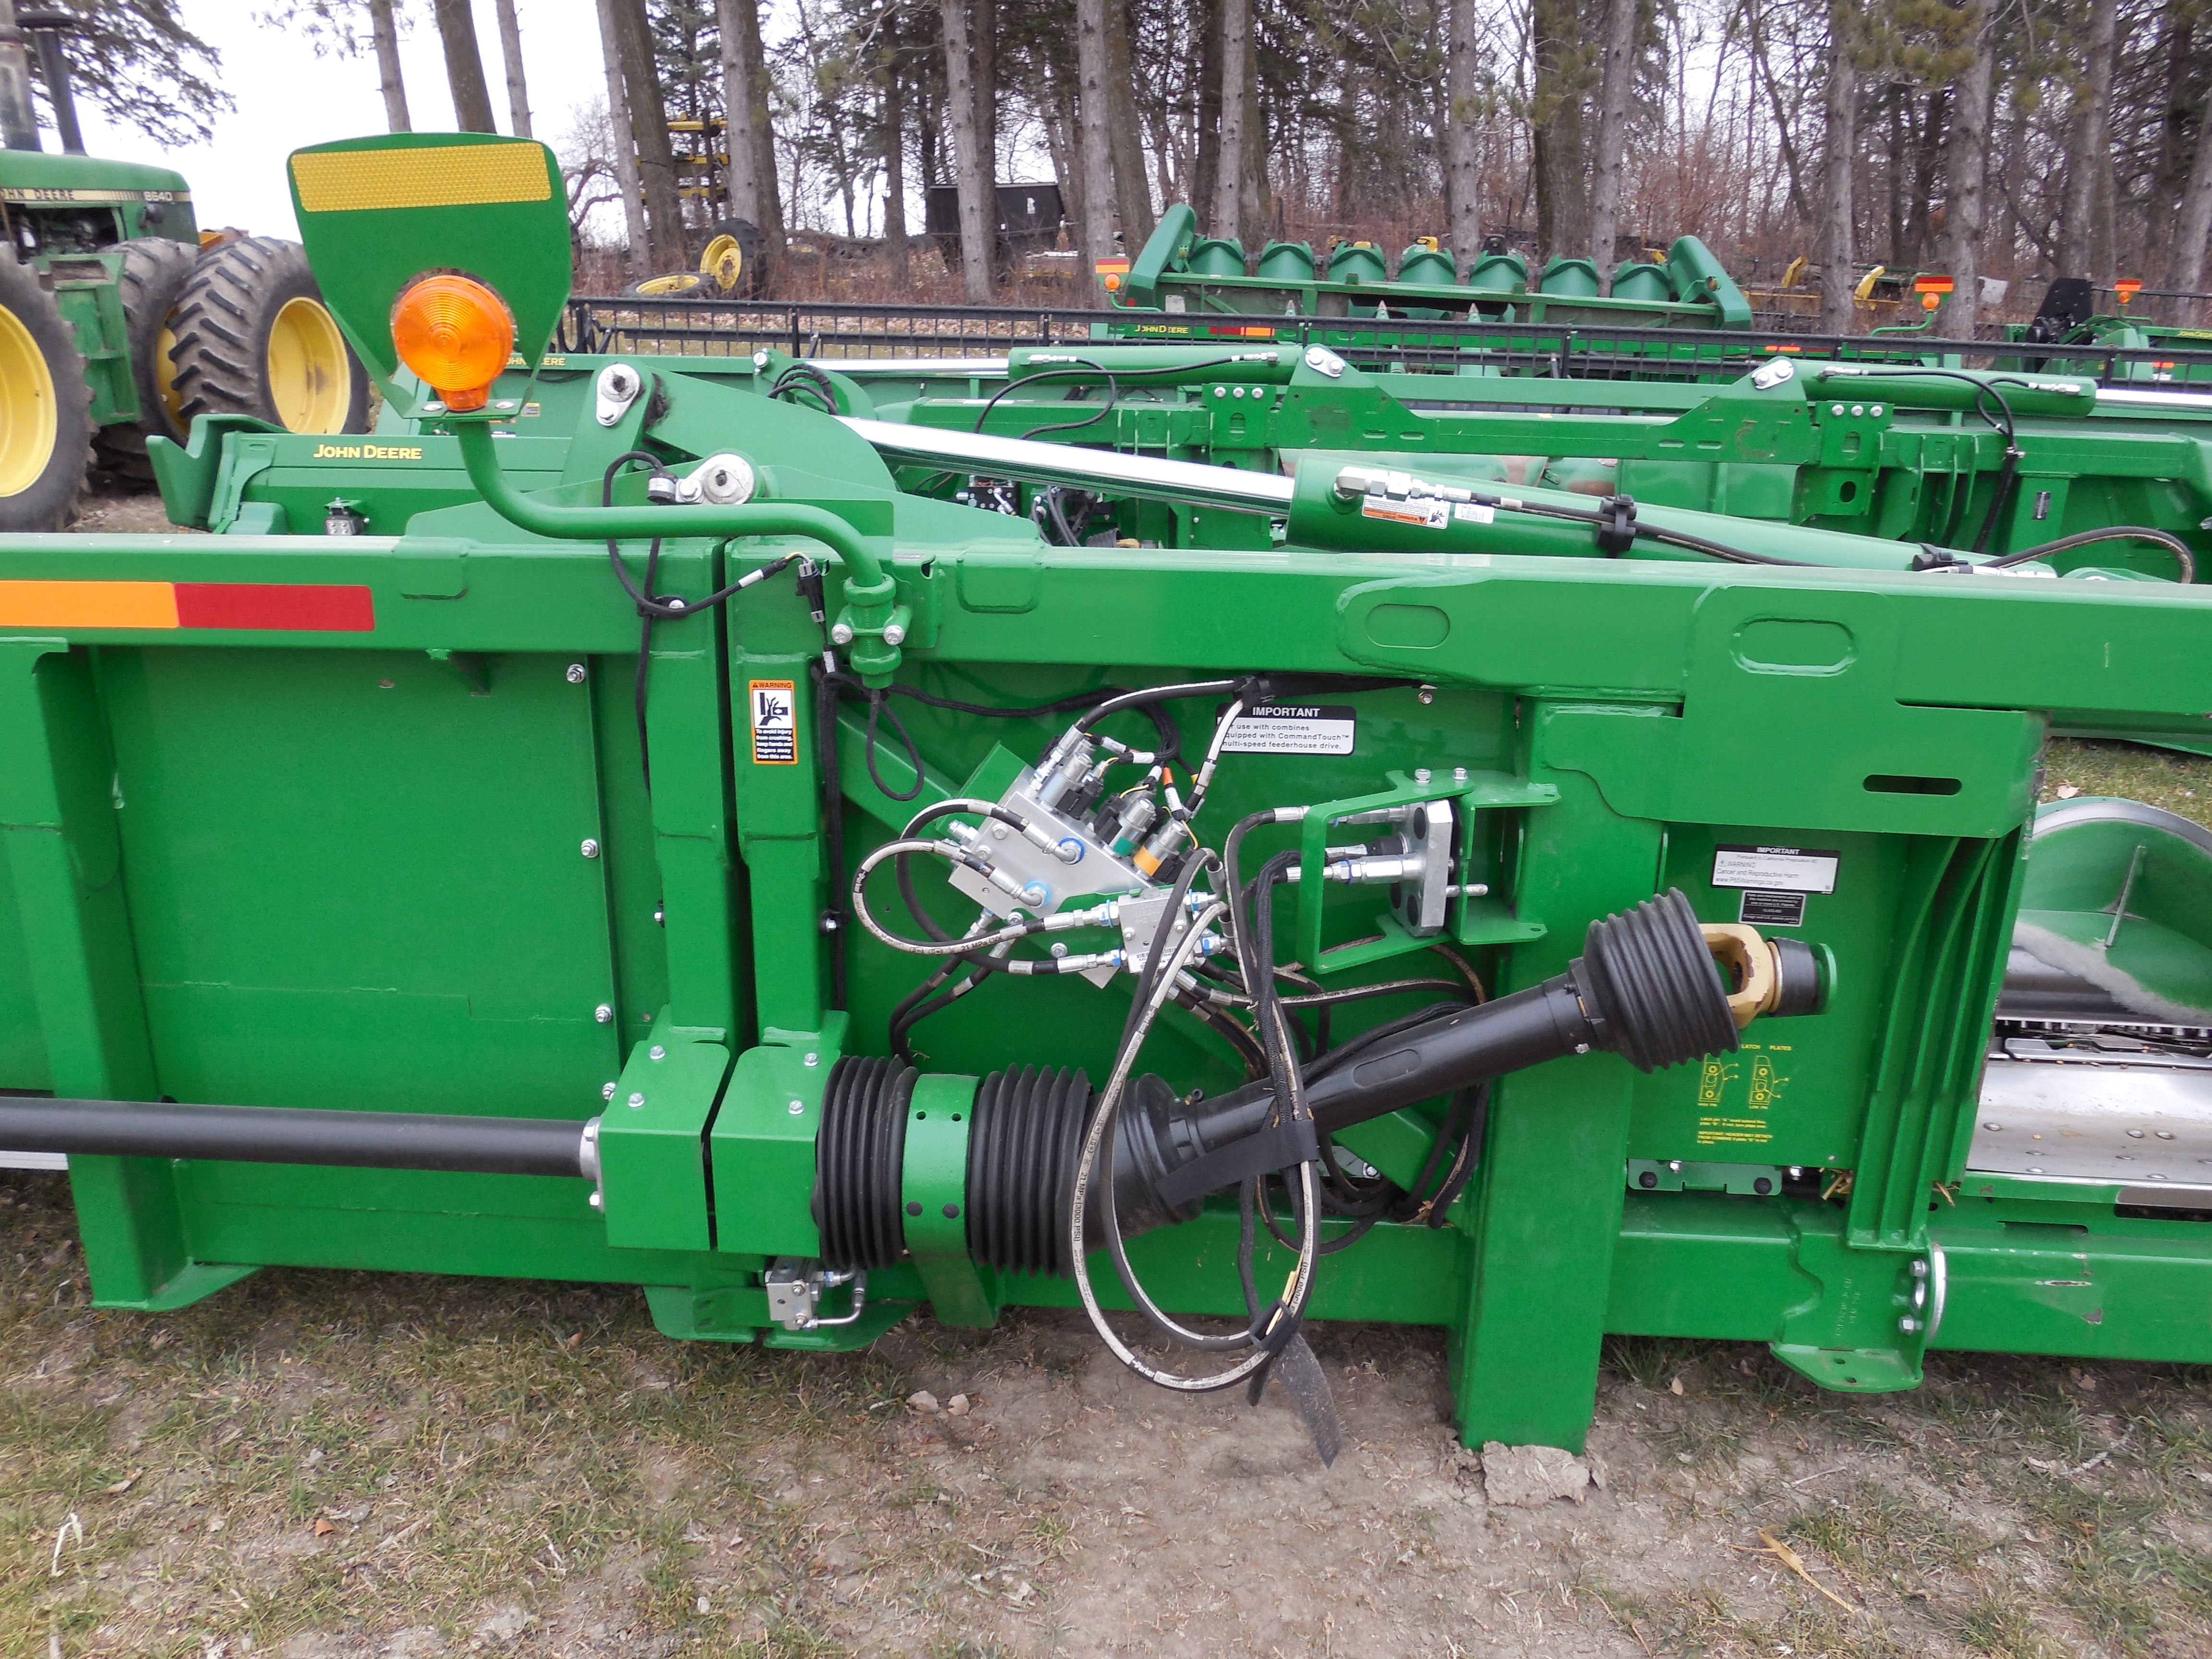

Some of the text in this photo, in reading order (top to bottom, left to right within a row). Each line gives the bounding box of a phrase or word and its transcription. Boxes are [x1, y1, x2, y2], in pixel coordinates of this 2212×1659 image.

[313, 444, 422, 459] JOHN DEERE
[1252, 707, 1320, 717] IMPORTANT
[1757, 847, 1801, 855] IMPORTANT
[1716, 877, 1783, 887] www.P65Warnings.ca.gov
[1081, 1172, 1087, 1180] 21
[1076, 1183, 1085, 1200] MPa
[1073, 1202, 1083, 1223] (3000
[1073, 1226, 1082, 1241] PSI)
[1293, 1282, 1304, 1304] (3000
[1300, 1262, 1309, 1279] PSI)
[1132, 1360, 1155, 1378] Parker
